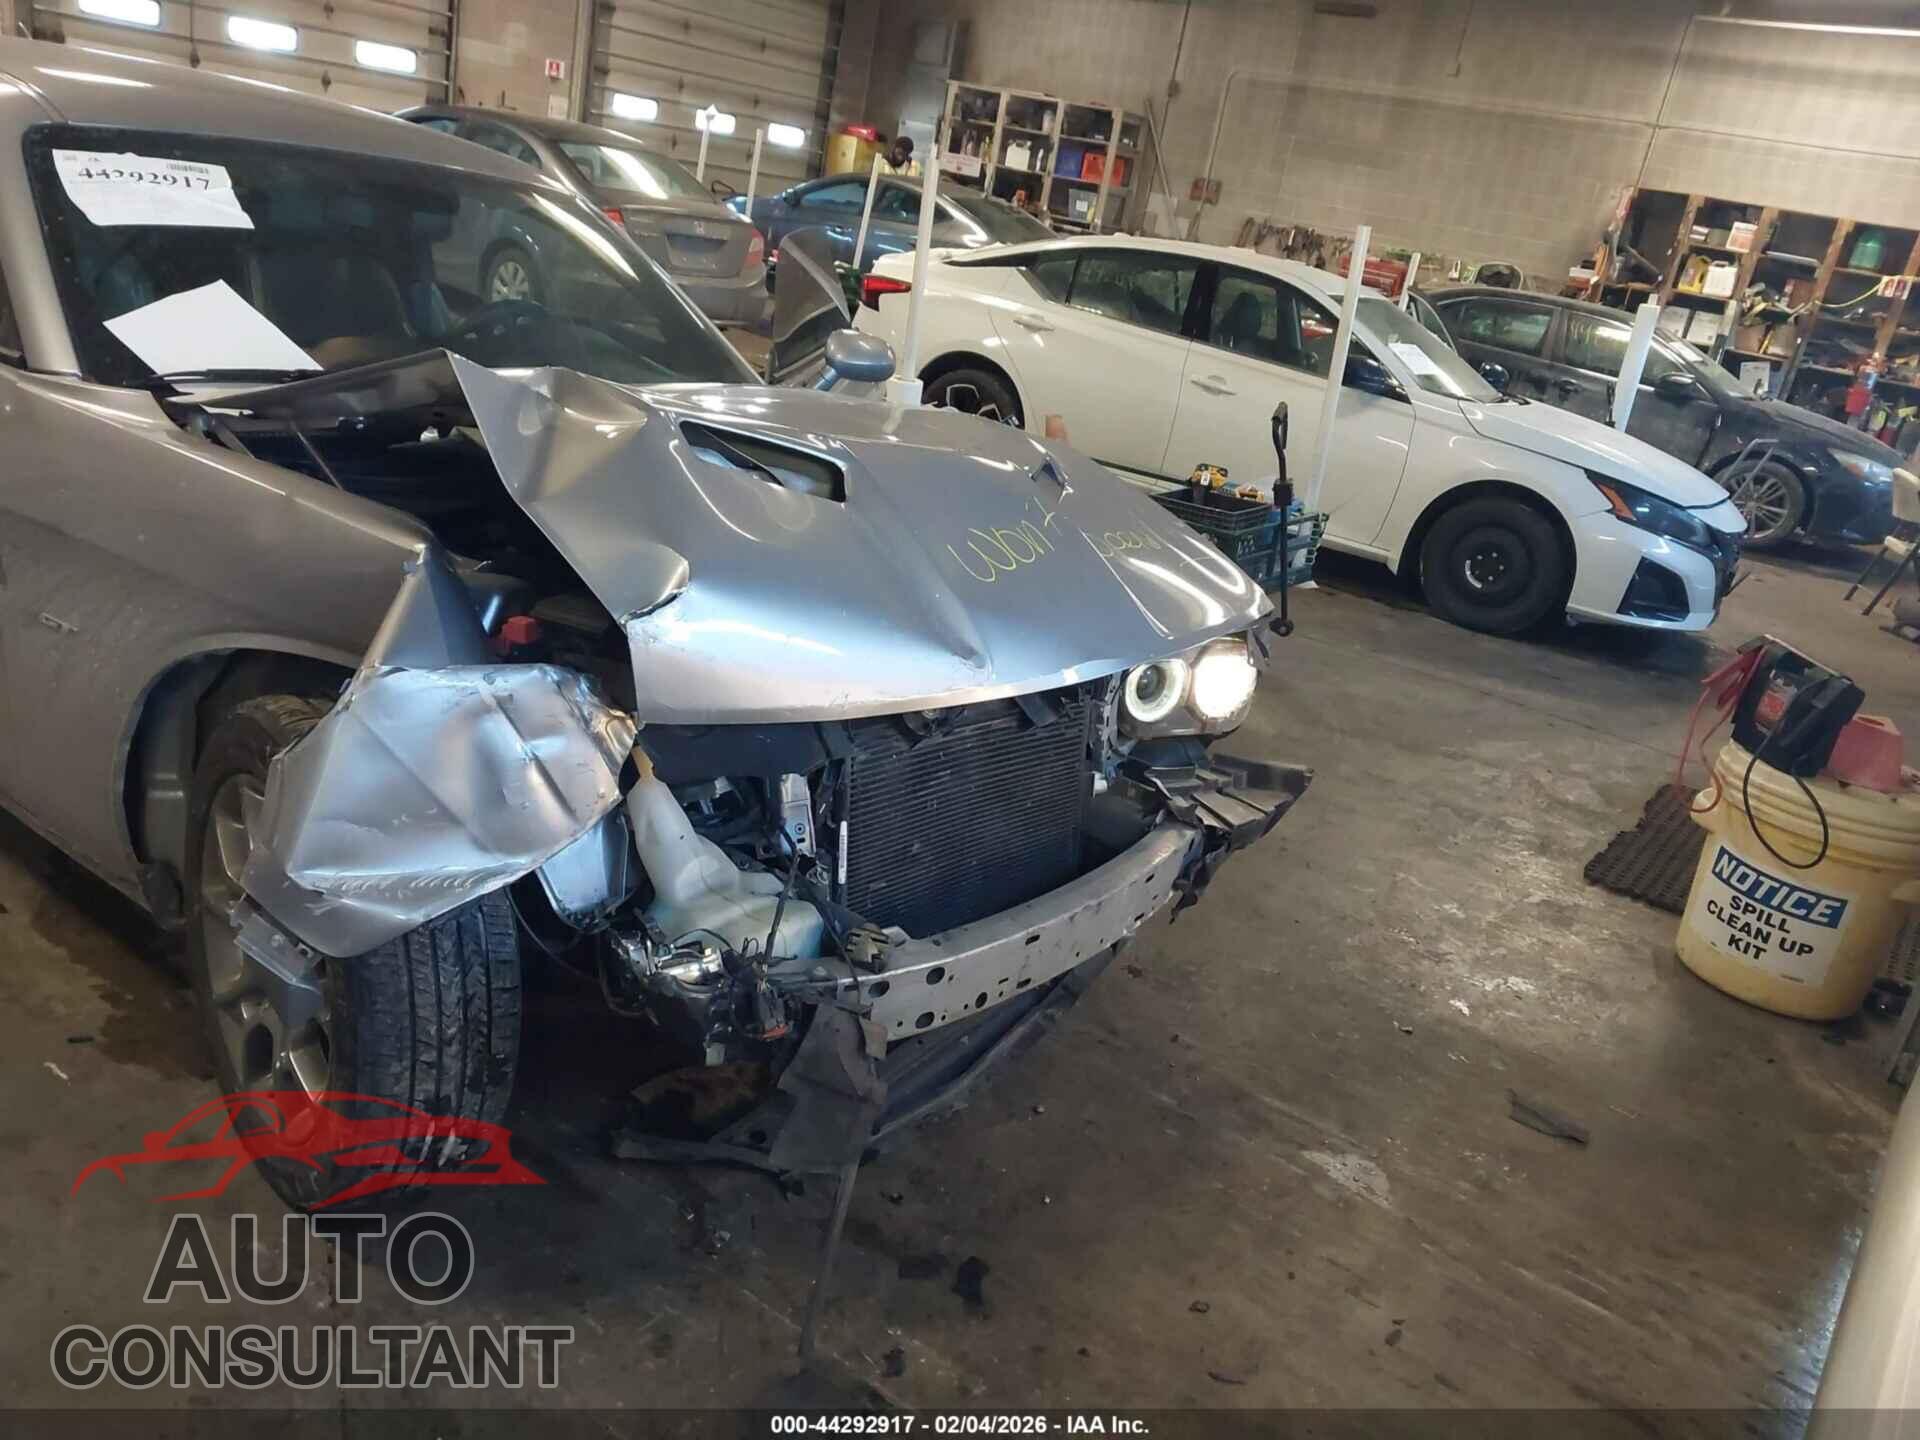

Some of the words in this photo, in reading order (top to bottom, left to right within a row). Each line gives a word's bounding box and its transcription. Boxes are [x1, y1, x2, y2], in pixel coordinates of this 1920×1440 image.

[1715, 854, 1841, 922] NOTICE
[1707, 899, 1772, 944] CLEAN
[1778, 937, 1815, 957] UP
[1729, 895, 1791, 934] SPILL
[1727, 934, 1767, 960] KIT
